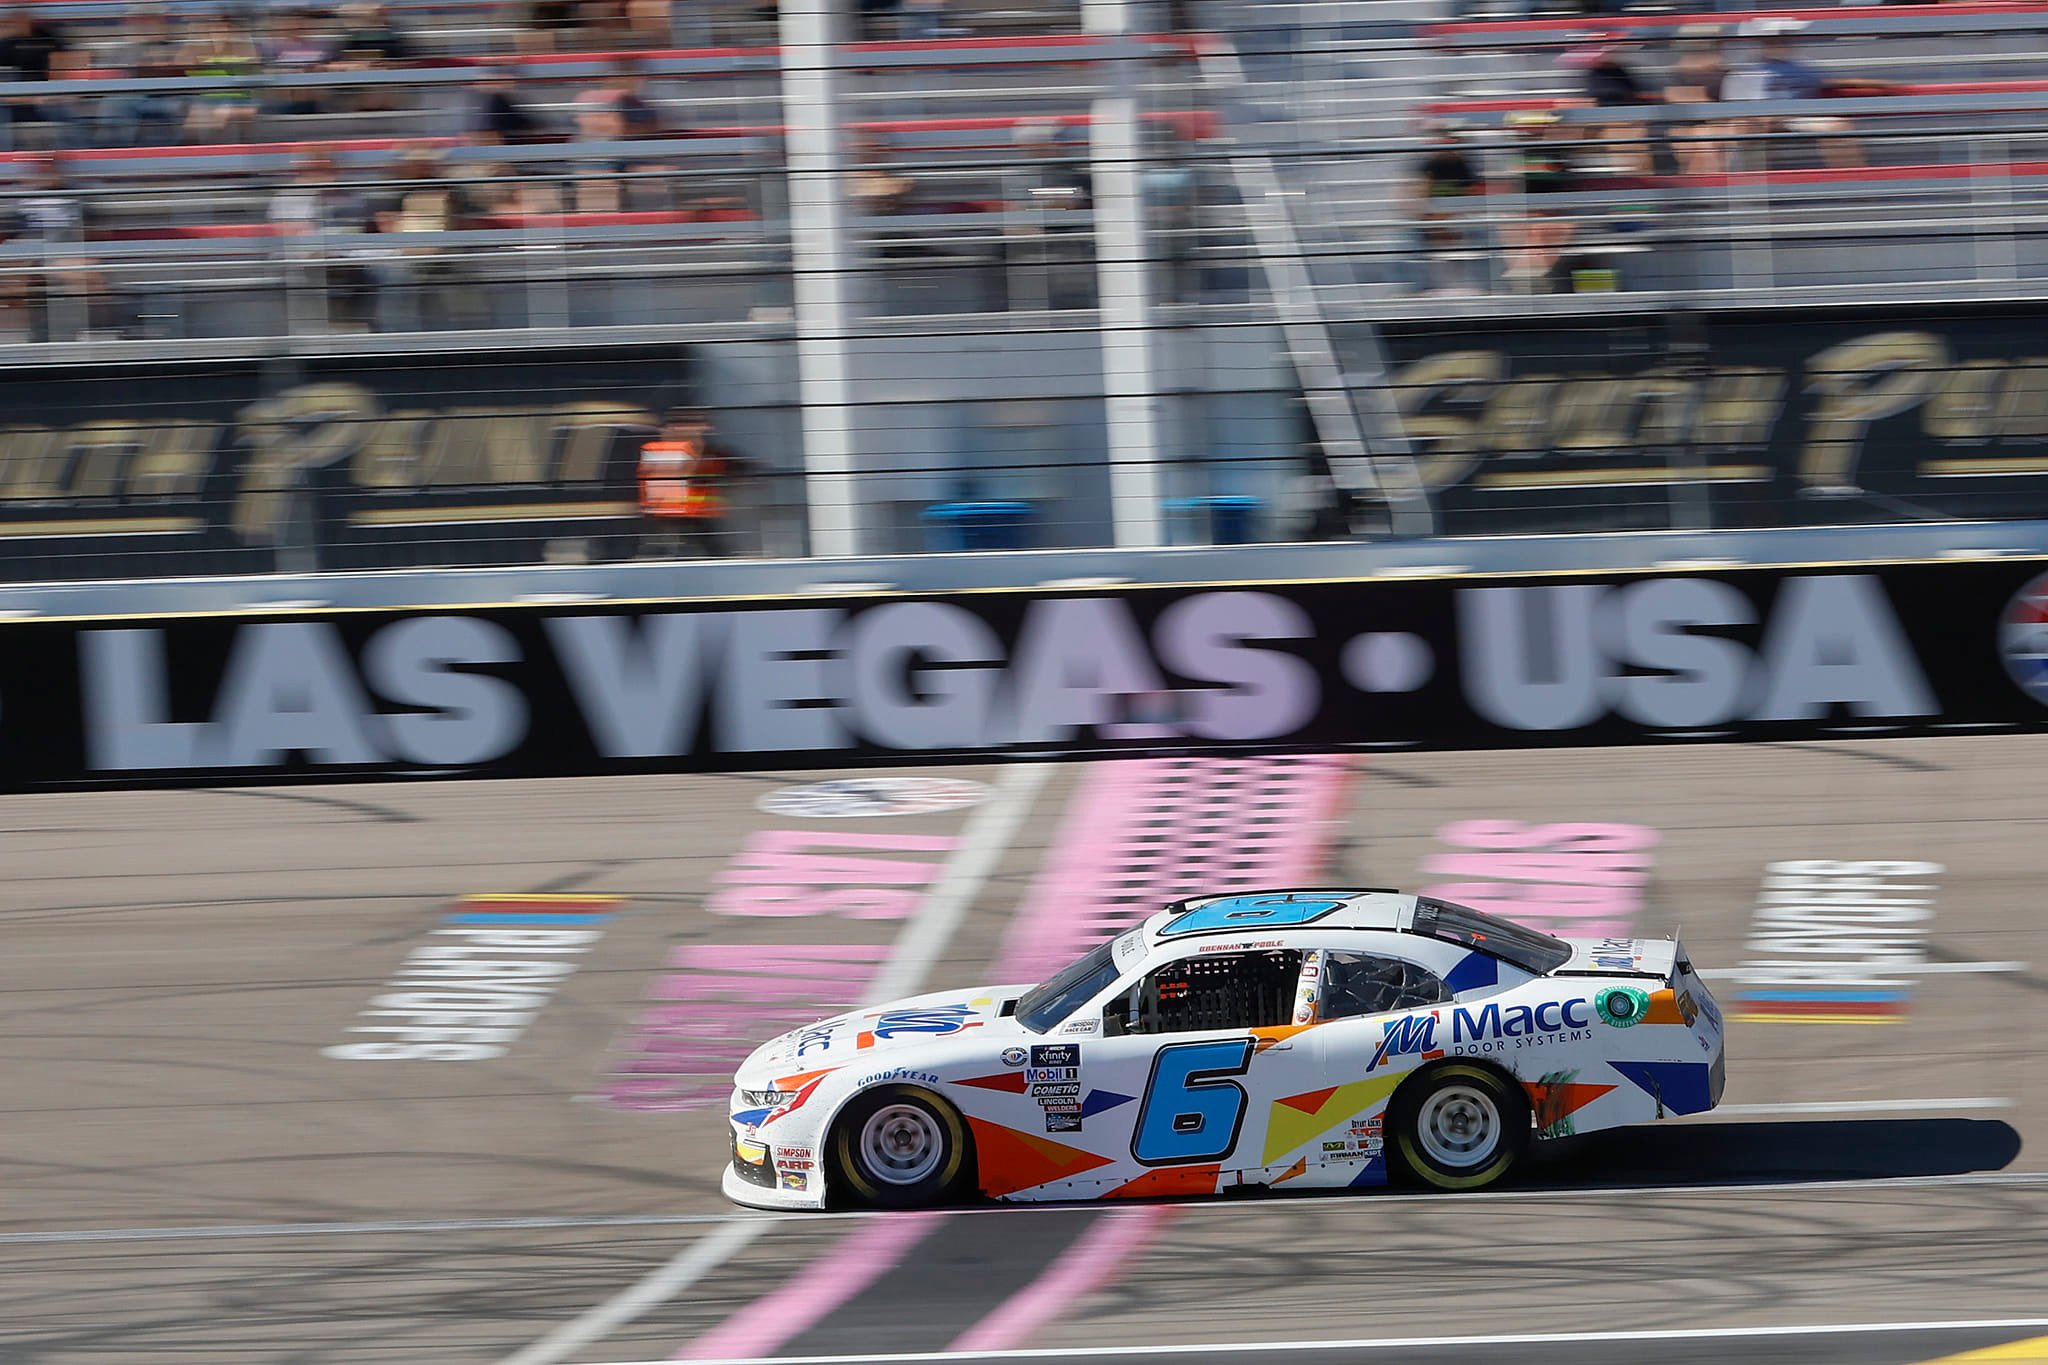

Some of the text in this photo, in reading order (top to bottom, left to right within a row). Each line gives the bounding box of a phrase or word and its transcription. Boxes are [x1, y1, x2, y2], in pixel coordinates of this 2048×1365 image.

[80, 575, 1943, 769] LAS VEGAS USA
[1199, 940, 1284, 952] BRENNAN POOLE
[319, 928, 609, 1061] PLAYOFFS
[1453, 998, 1588, 1043] Macc
[1454, 1029, 1593, 1056] DOOR SYSTEMS
[1039, 1050, 1071, 1062] xfinity
[857, 1067, 939, 1087] GOODYEAR
[1026, 1068, 1062, 1081] Mobil
[1033, 1085, 1079, 1095] COMETIC
[1130, 1037, 1257, 1167] 6
[777, 1148, 811, 1158] SIMPSON
[777, 1160, 814, 1170] ARP
